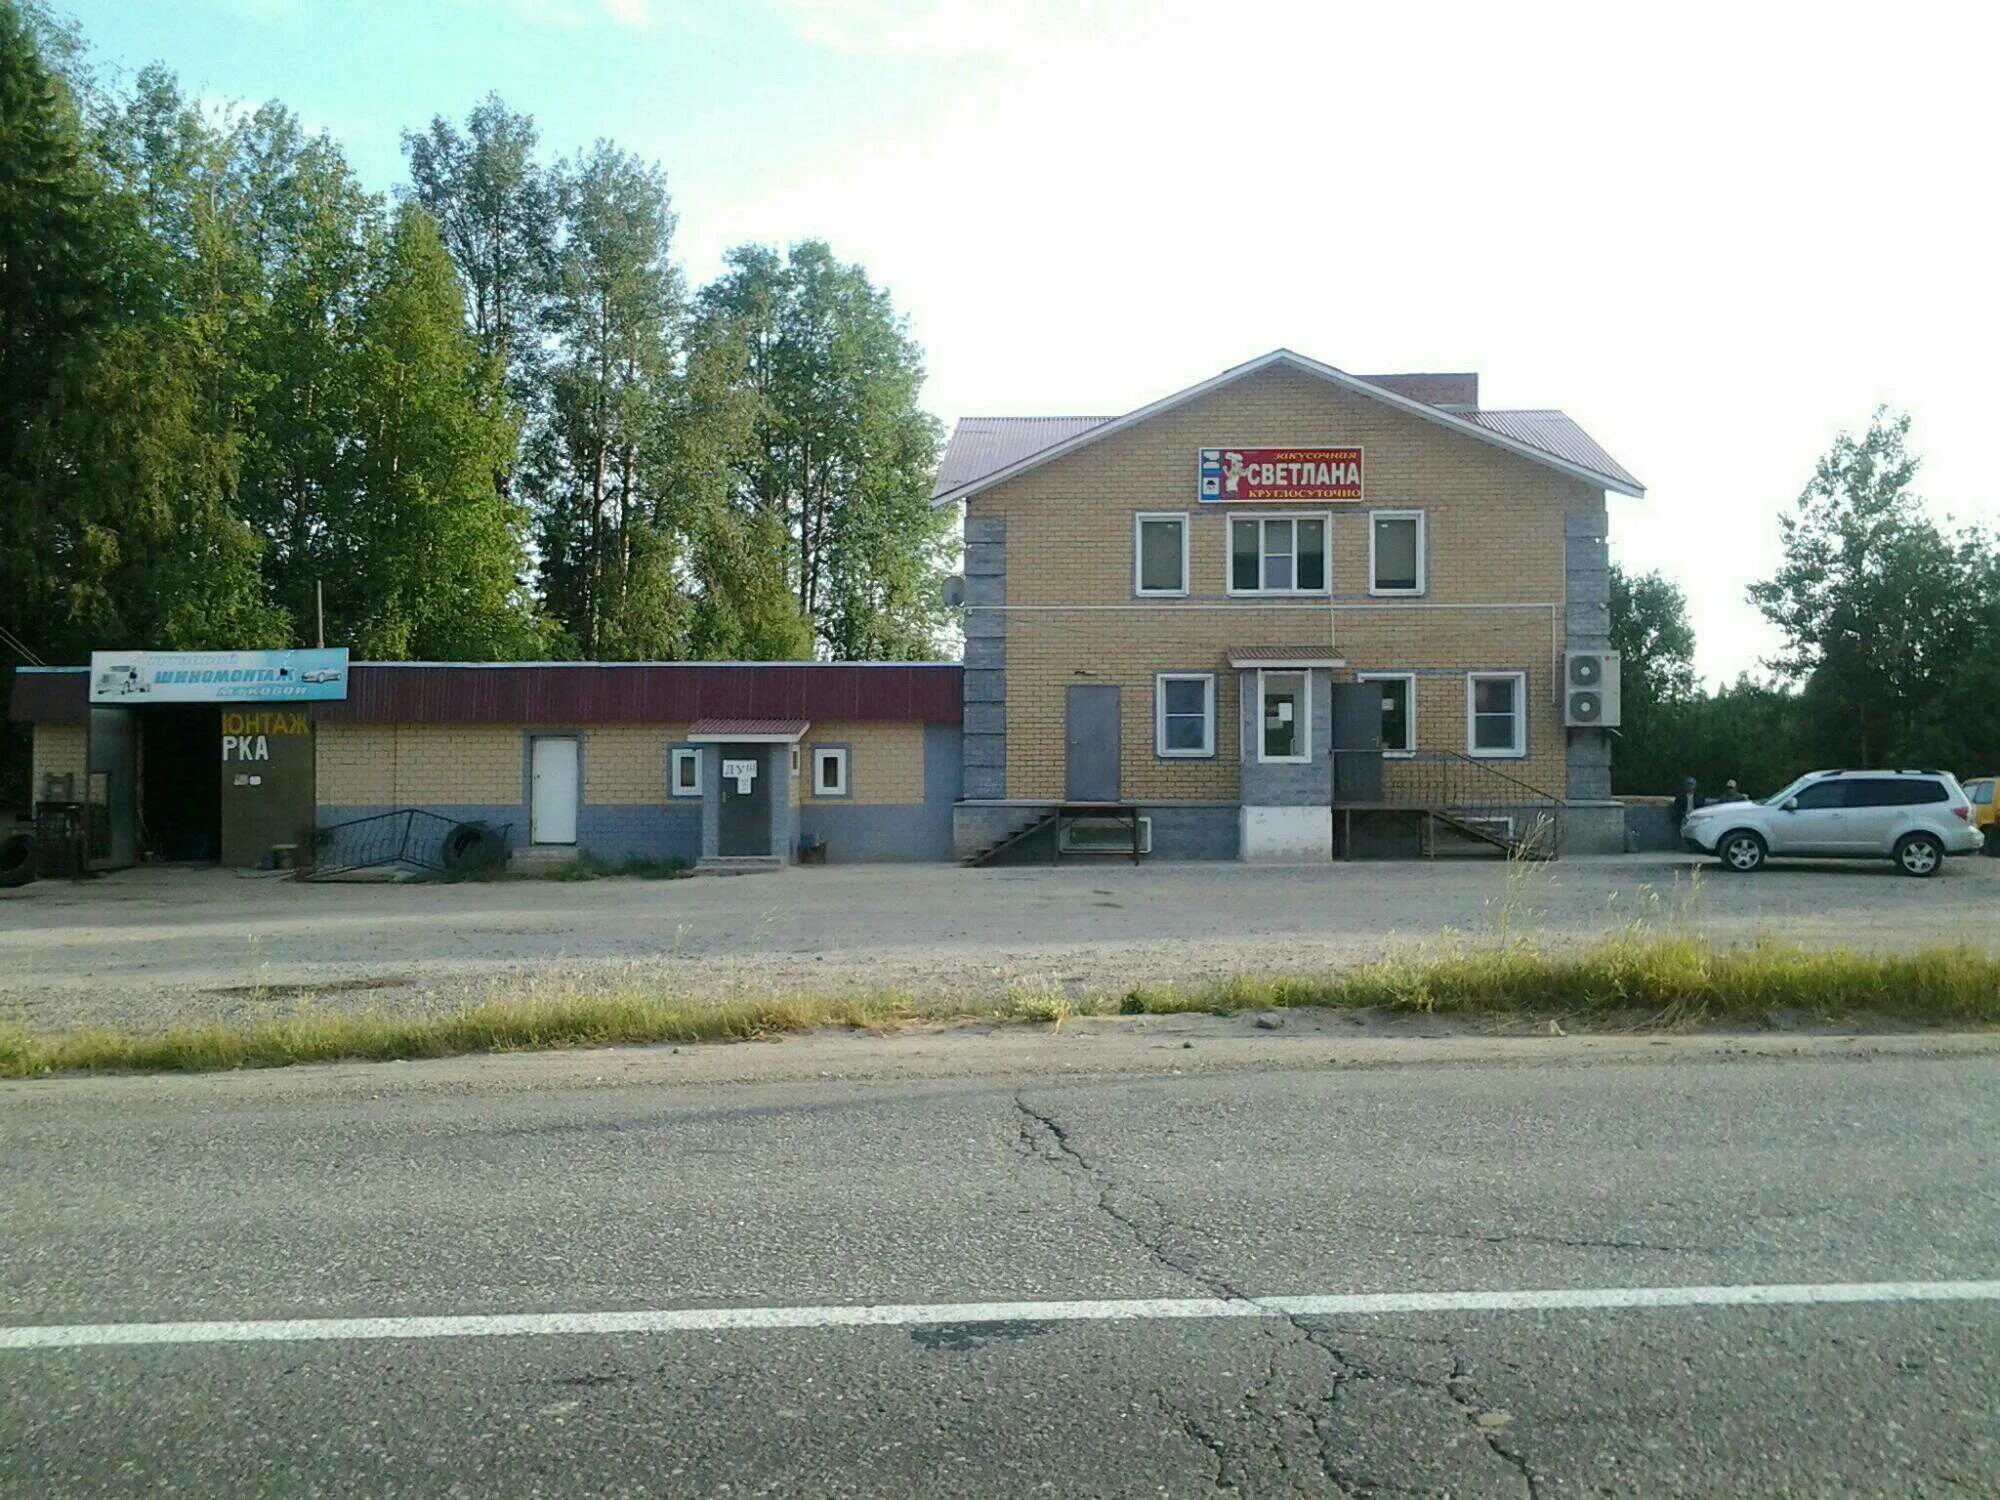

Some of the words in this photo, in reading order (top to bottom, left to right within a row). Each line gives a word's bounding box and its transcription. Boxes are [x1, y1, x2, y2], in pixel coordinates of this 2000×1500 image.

[1248, 463, 1360, 485] СВЕТЛАНА
[1249, 489, 1361, 498] КРУГЛОСУТОЧНО
[154, 669, 297, 684] ШИНОМОНТАЖ
[223, 735, 269, 760] РКА
